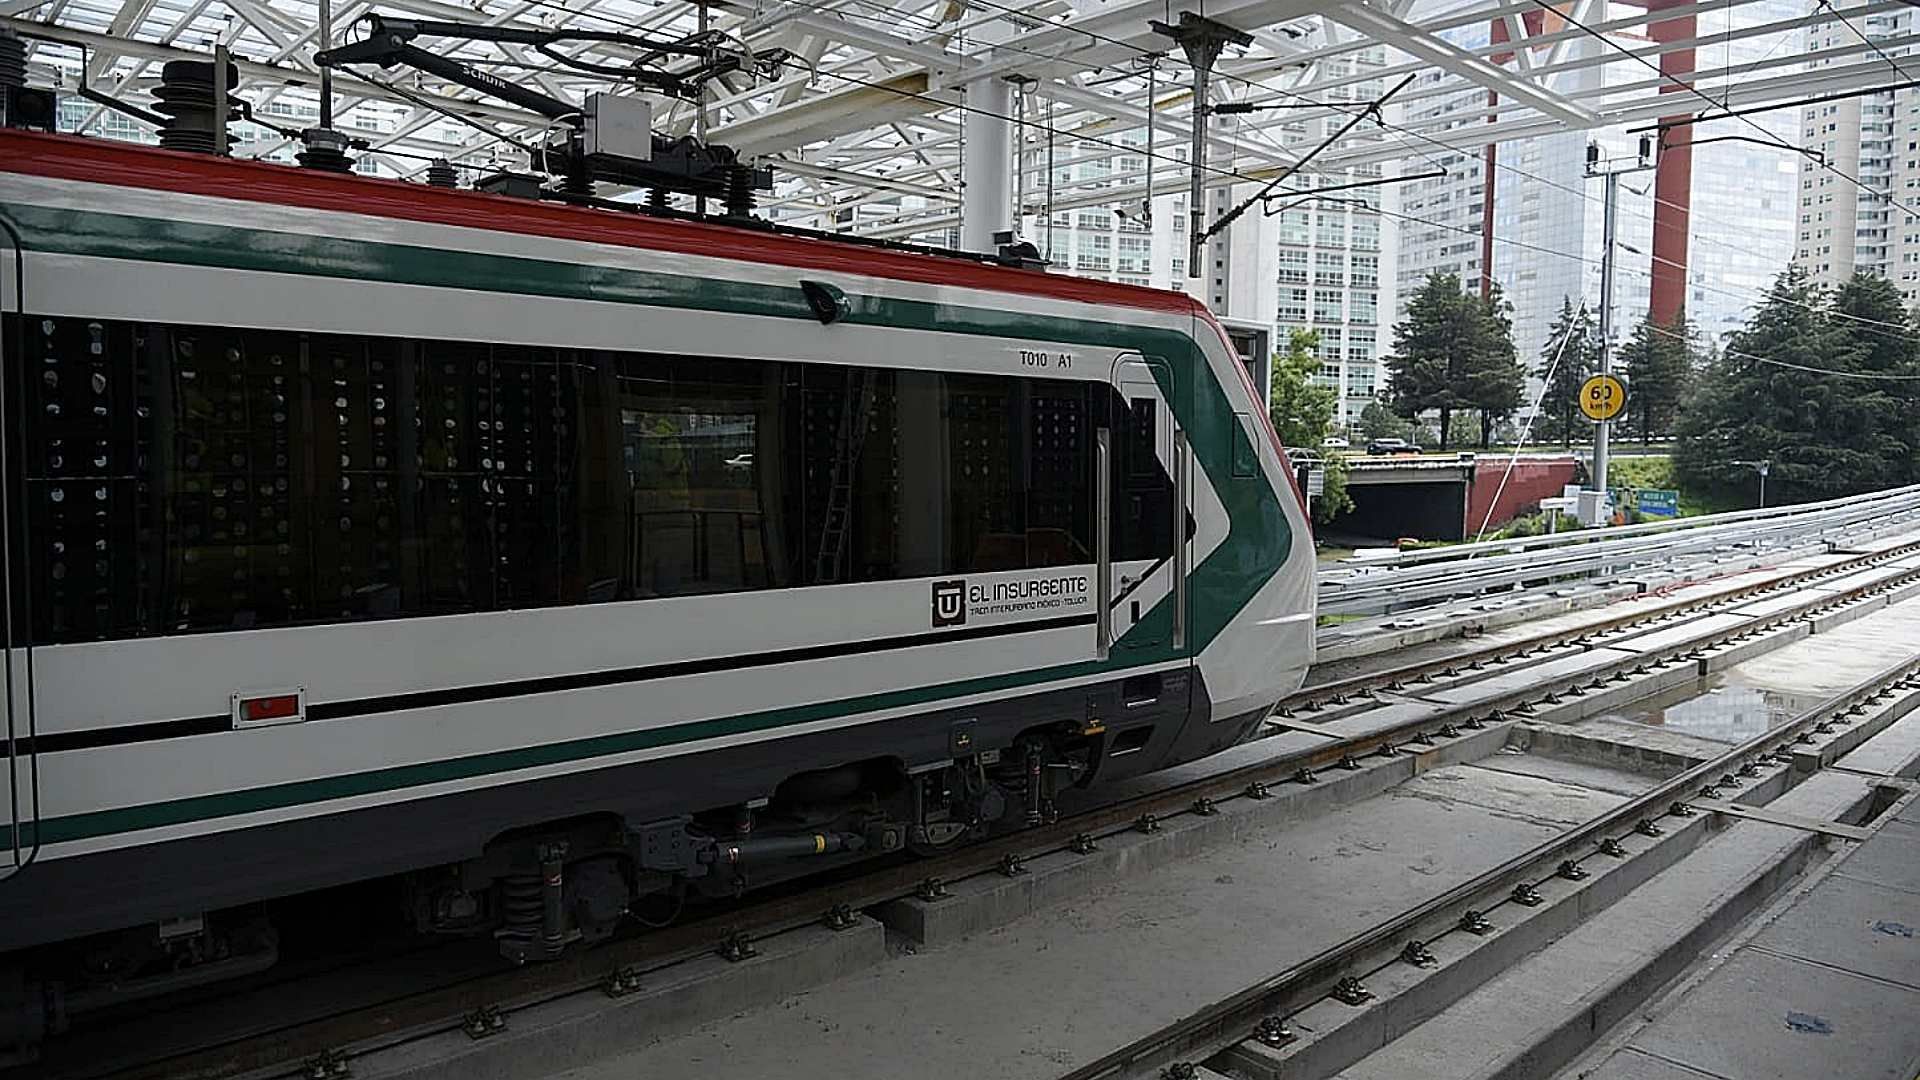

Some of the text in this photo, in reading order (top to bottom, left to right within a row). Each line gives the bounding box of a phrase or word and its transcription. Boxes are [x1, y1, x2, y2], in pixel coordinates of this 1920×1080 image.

[1020, 350, 1072, 368] T010 A1
[1591, 385, 1613, 400] 60
[969, 576, 1088, 603] EL INSURGENTE
